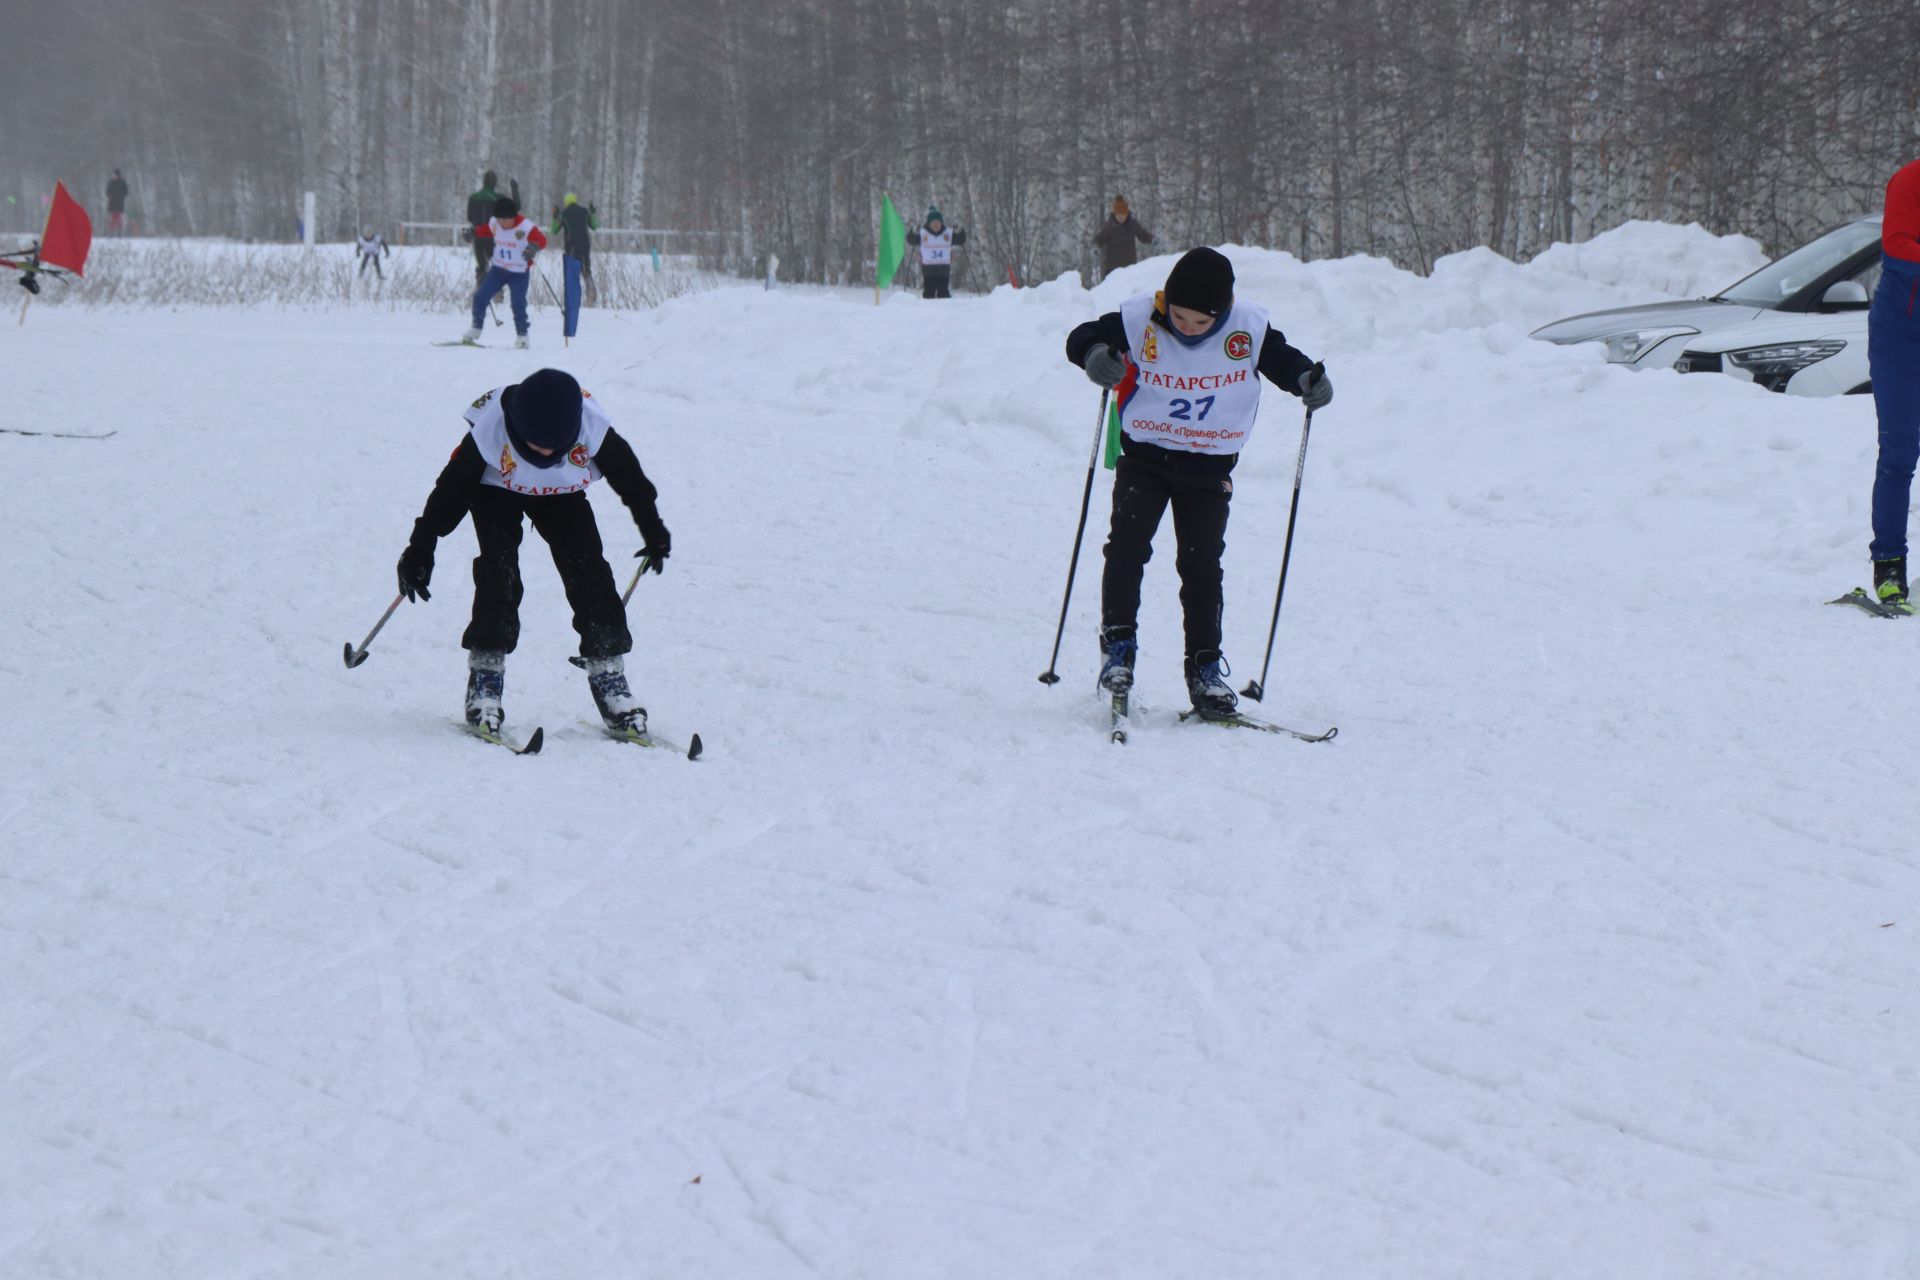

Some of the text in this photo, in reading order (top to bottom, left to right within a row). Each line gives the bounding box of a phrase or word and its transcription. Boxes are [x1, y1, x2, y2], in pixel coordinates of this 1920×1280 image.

[500, 248, 512, 260] 11
[1142, 369, 1247, 390] ТАТАРСТАН
[1169, 395, 1215, 421] 27
